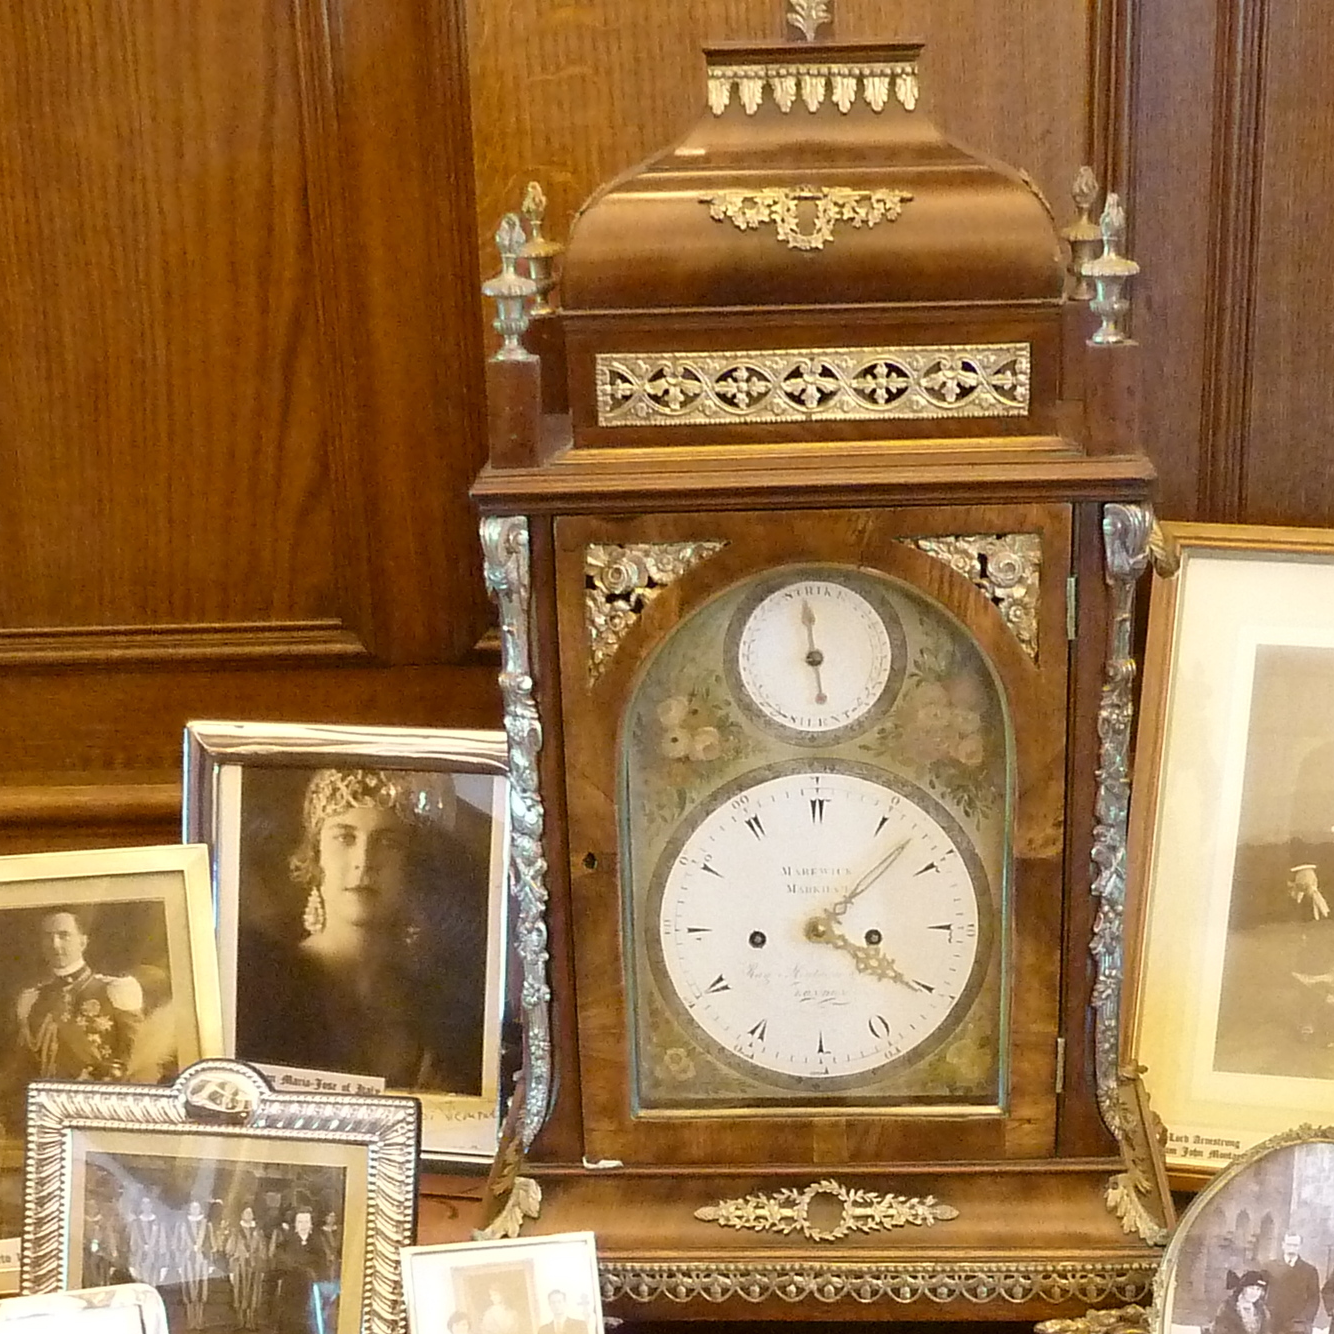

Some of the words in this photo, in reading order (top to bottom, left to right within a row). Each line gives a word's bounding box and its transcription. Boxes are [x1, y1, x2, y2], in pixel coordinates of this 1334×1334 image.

[342, 1082, 351, 1092] of
[357, 1083, 382, 1095] Italy
[1169, 1132, 1189, 1143] Lord
[1193, 1134, 1241, 1149] Armstrong
[1181, 1146, 1204, 1158] John
